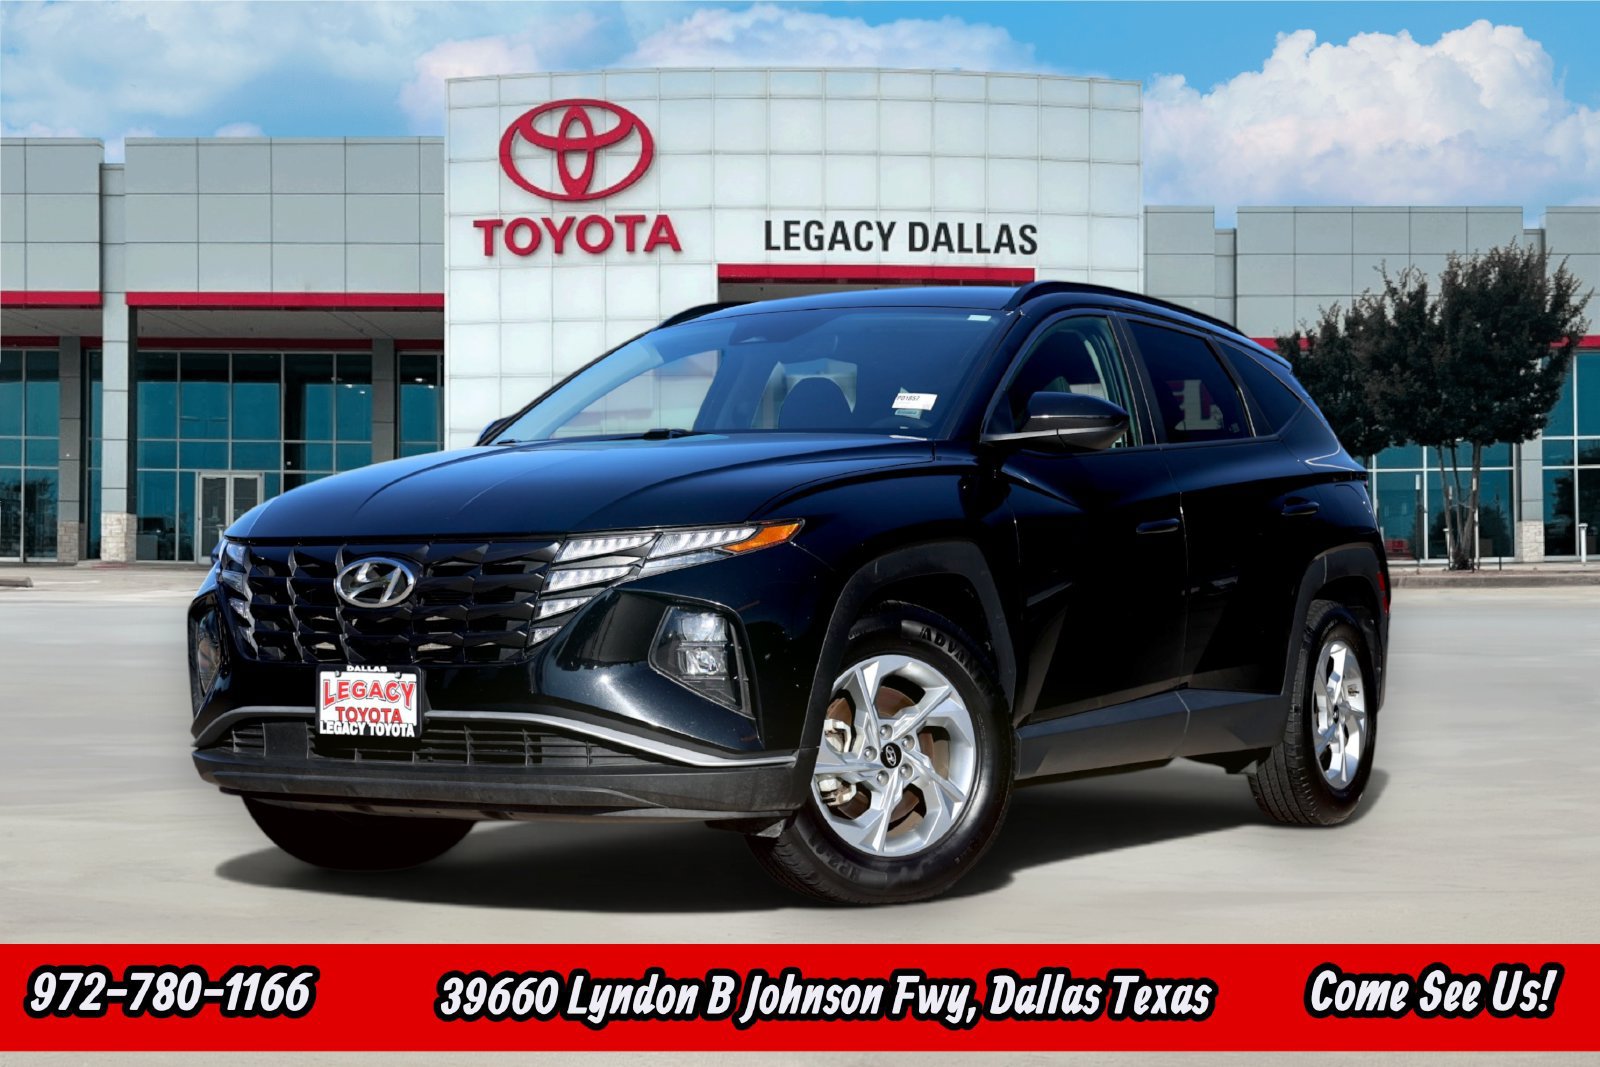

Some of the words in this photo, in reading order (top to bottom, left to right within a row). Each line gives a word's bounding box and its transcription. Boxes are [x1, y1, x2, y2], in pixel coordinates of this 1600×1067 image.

[473, 214, 682, 257] TOYOTA
[764, 219, 897, 252] LEGACY
[908, 221, 1038, 255] DALLAS
[323, 679, 417, 710] LEGACY
[320, 720, 366, 736] LEGACY
[366, 722, 415, 738] TOYOTA
[335, 706, 402, 724] TOYOTA
